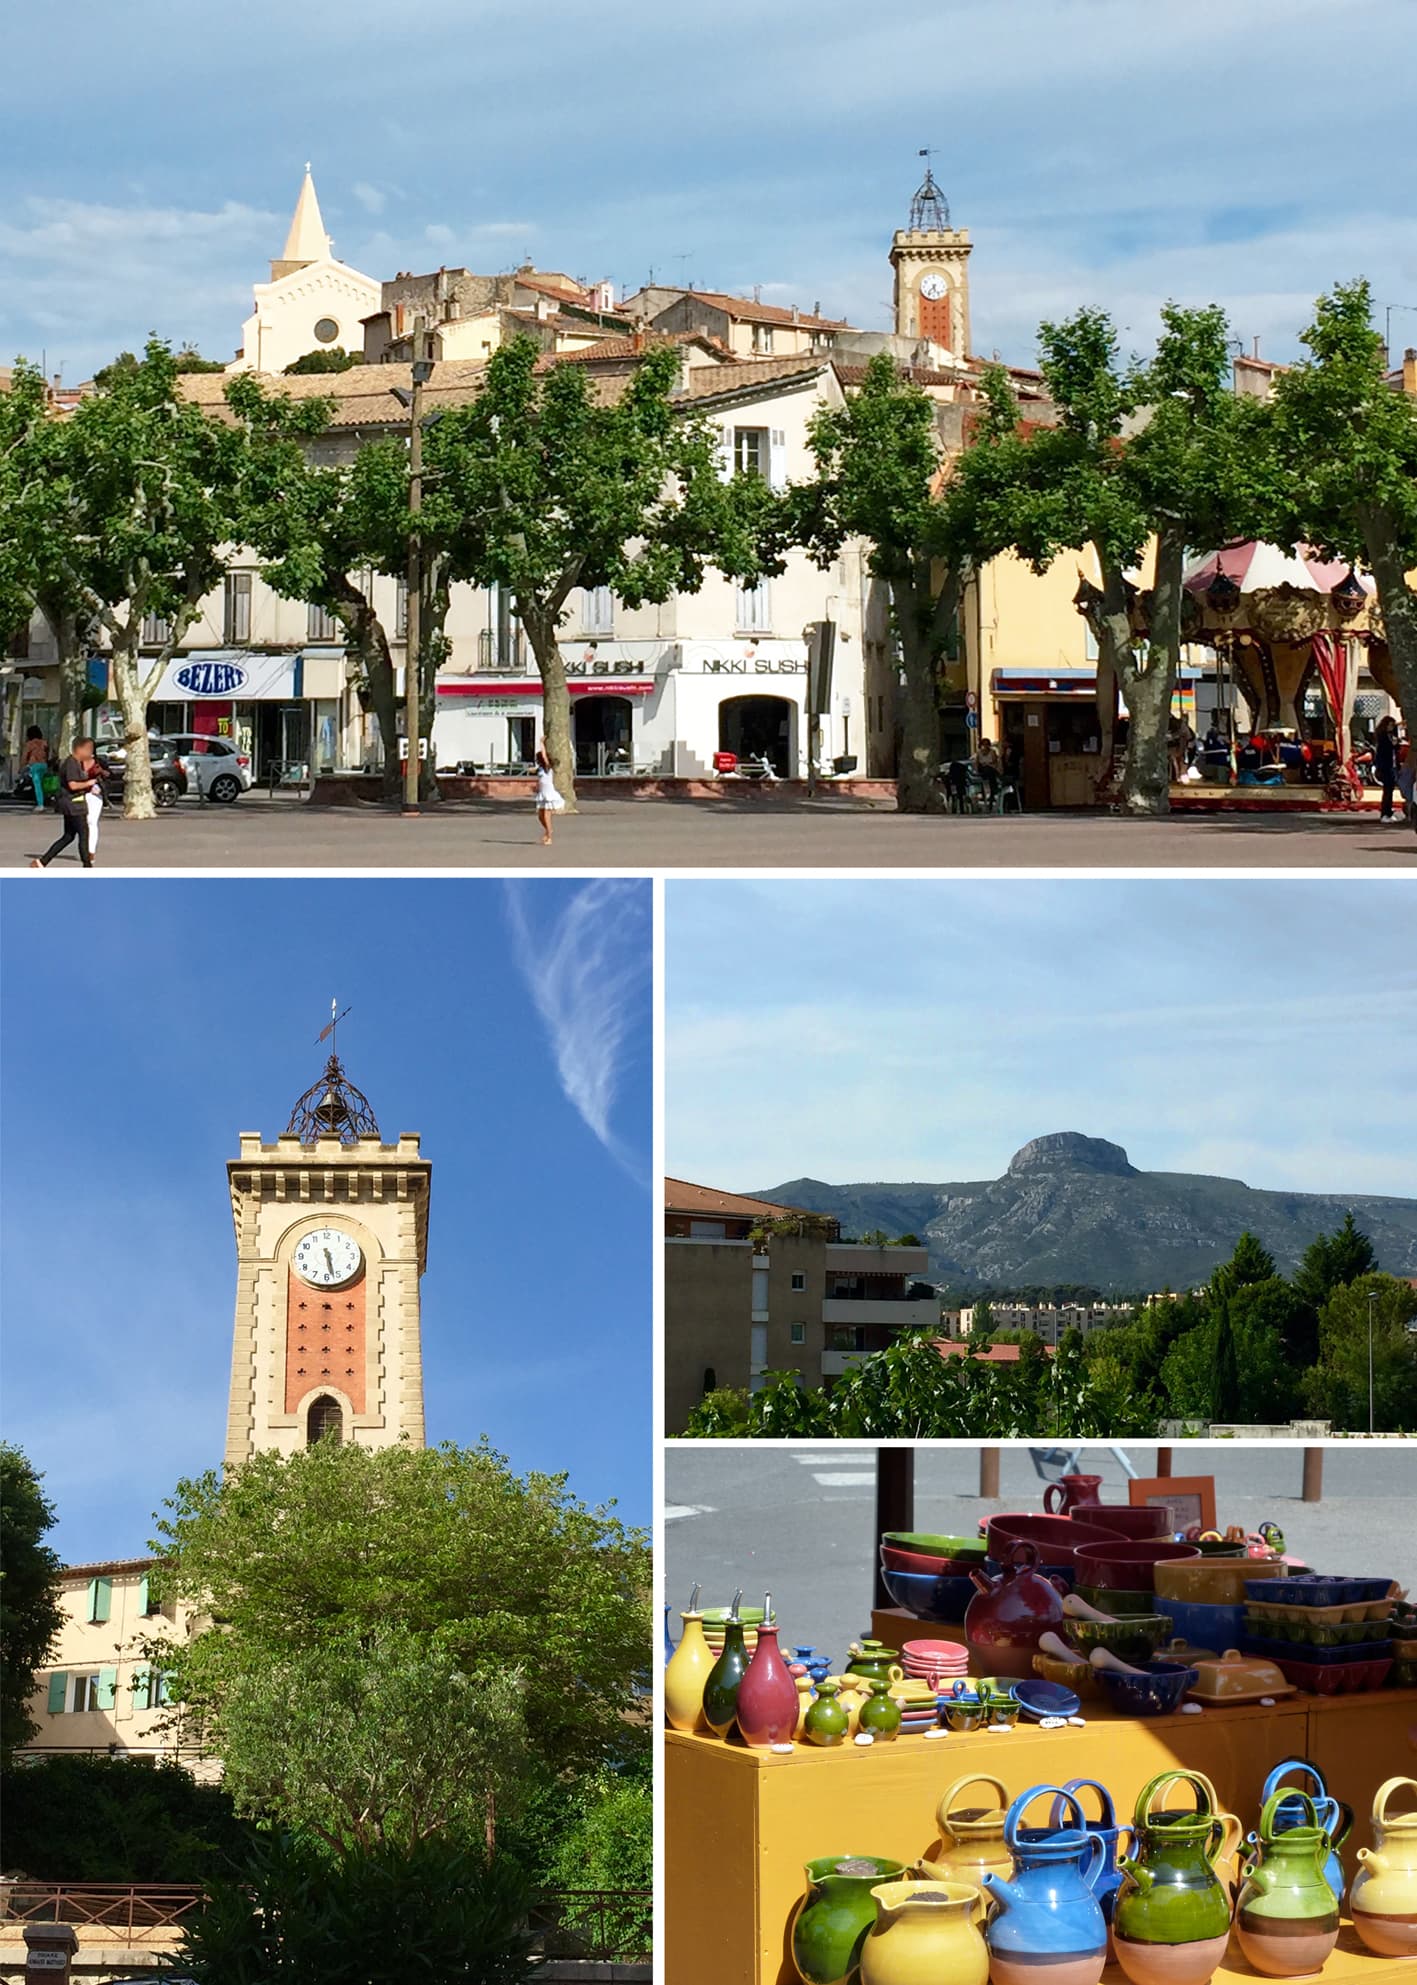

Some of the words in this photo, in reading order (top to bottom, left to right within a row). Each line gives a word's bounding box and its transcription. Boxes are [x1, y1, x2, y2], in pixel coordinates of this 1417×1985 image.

[754, 659, 809, 673] SUSH
[177, 663, 245, 694] BEZERT
[302, 1242, 311, 1250] 10
[345, 1242, 351, 1250] 2
[298, 1252, 304, 1260] 9
[350, 1252, 356, 1260] 3
[302, 1263, 308, 1271] 8
[312, 1270, 318, 1278] 7
[324, 1273, 330, 1281] 6
[335, 1270, 342, 1278] 5
